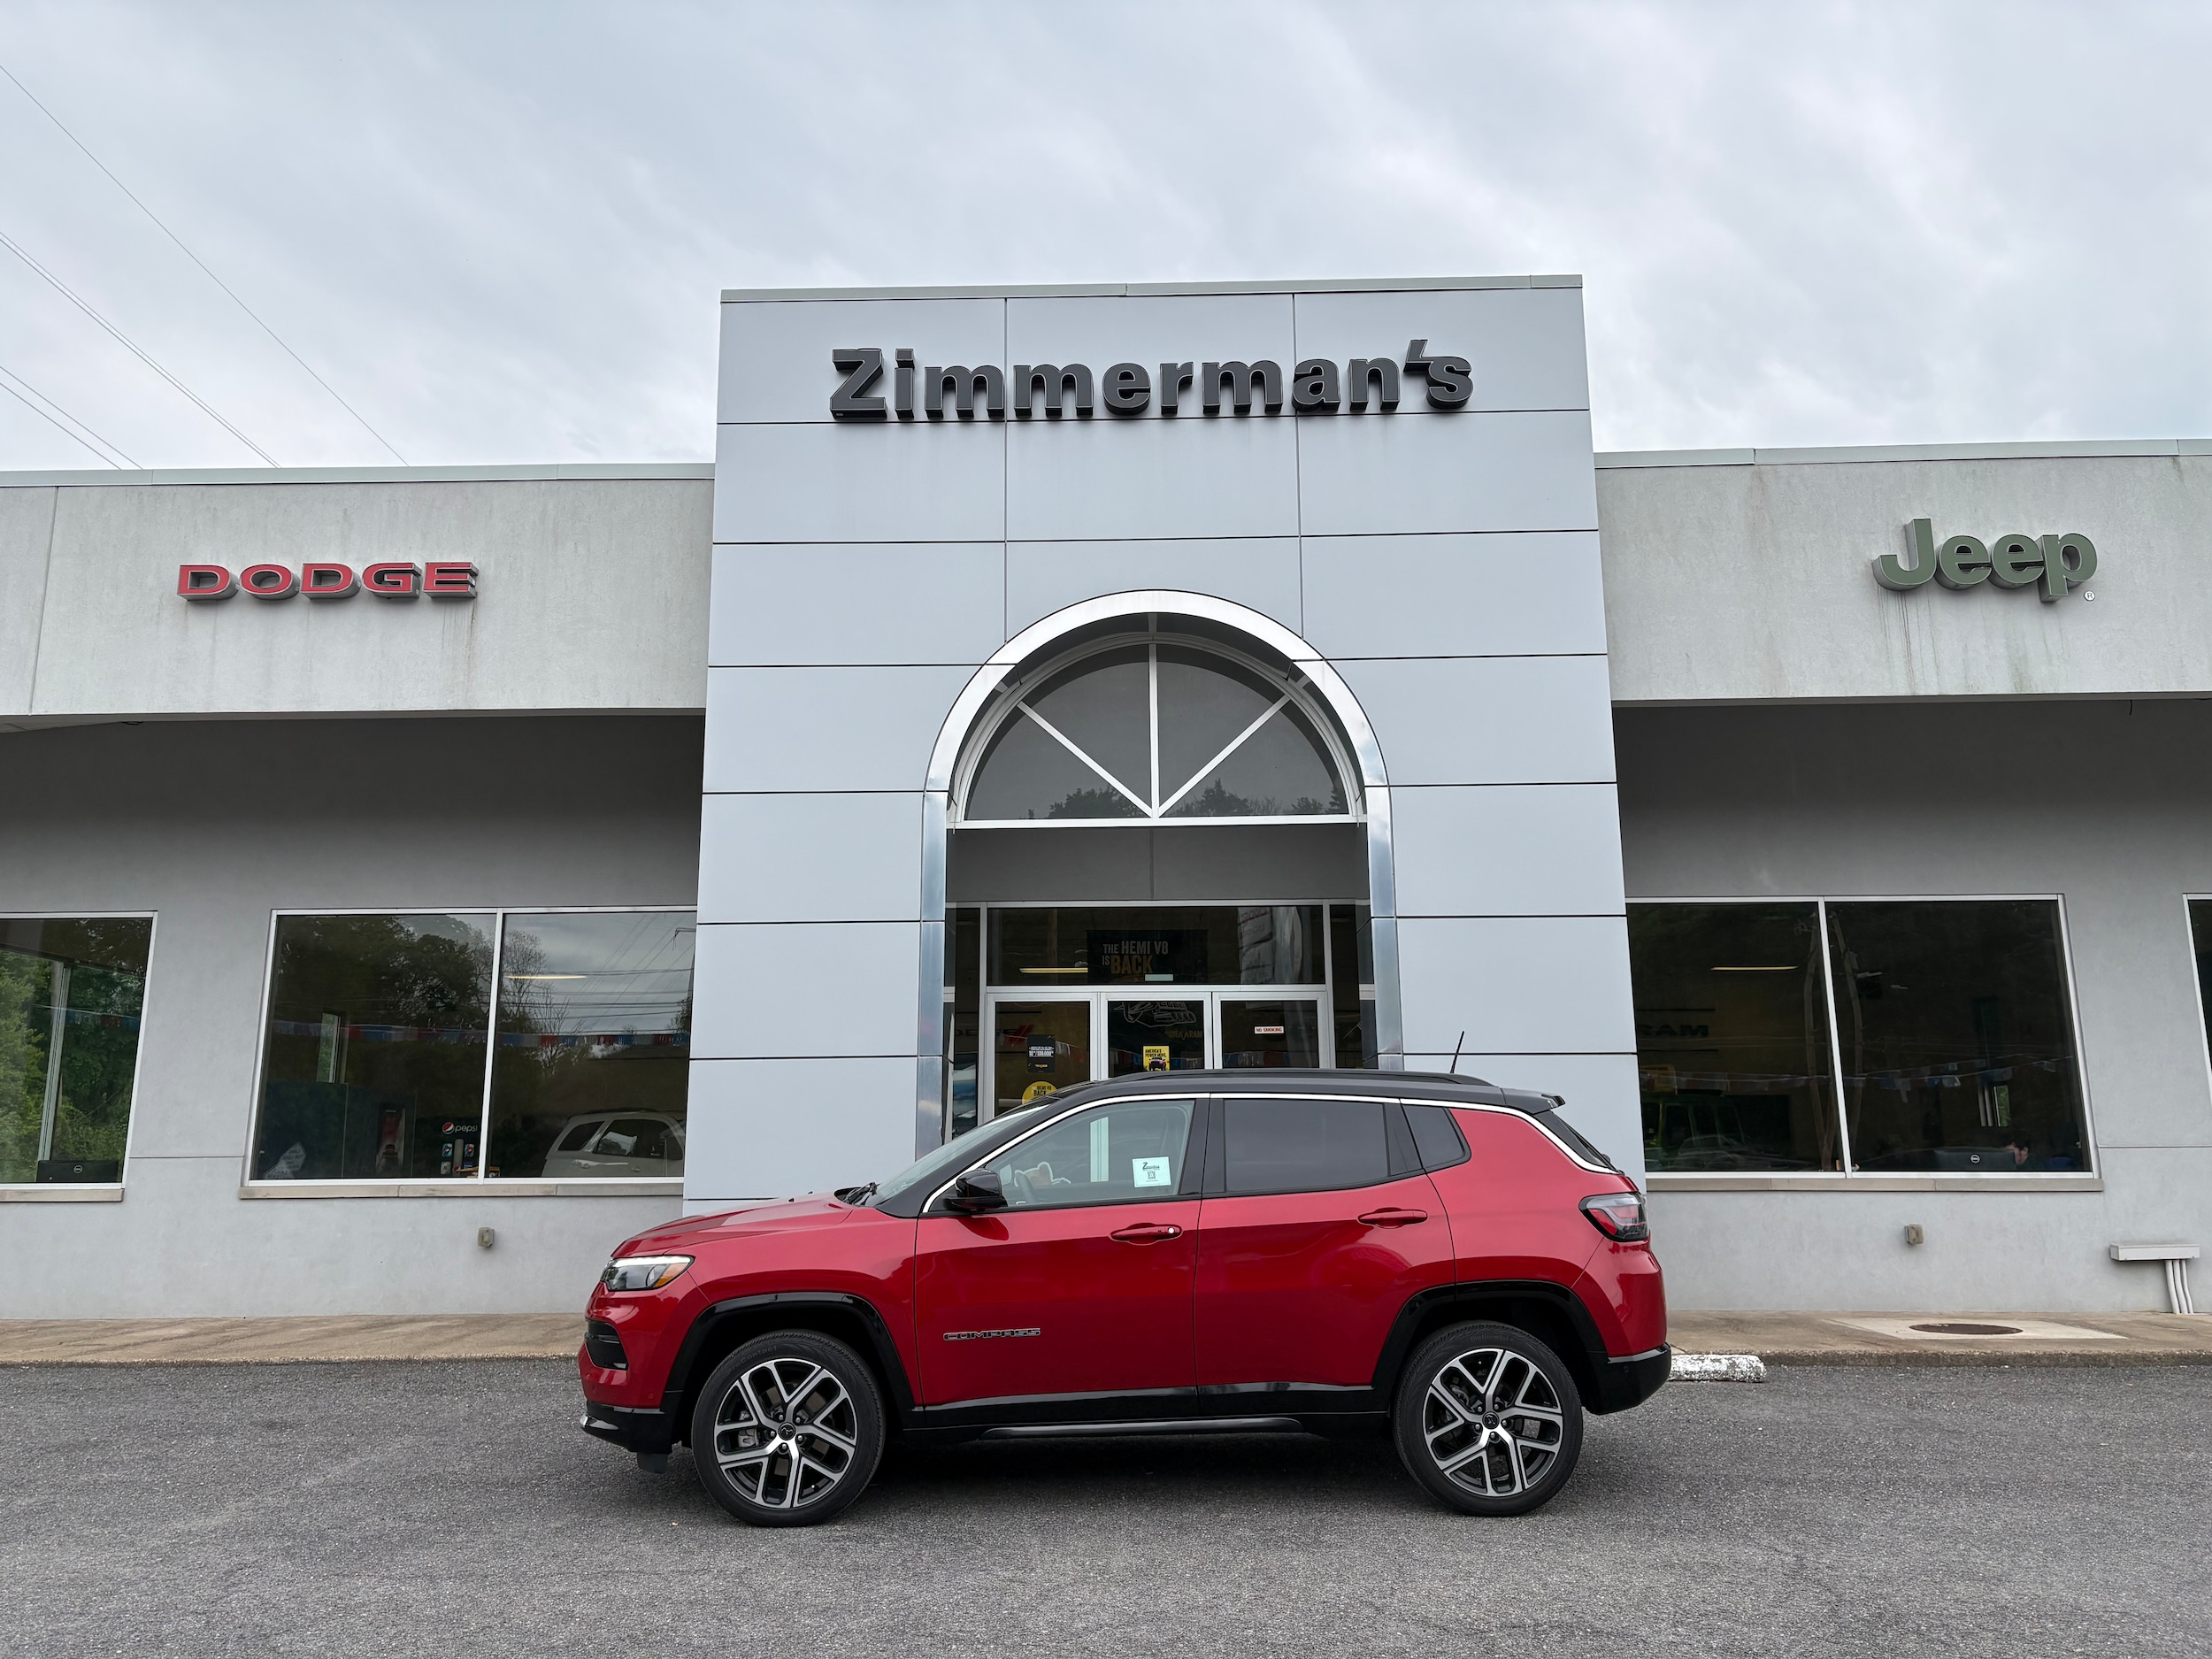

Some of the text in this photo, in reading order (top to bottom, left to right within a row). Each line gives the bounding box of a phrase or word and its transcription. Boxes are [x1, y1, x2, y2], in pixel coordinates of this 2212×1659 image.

[829, 339, 1474, 420] Zimmerman's
[1871, 517, 2098, 603] Jeep
[177, 562, 479, 600] DODGE
[1102, 941, 1169, 955] THE HEMI V8
[1102, 955, 1154, 974] IS BACK
[943, 1327, 1041, 1341] COMPASS
